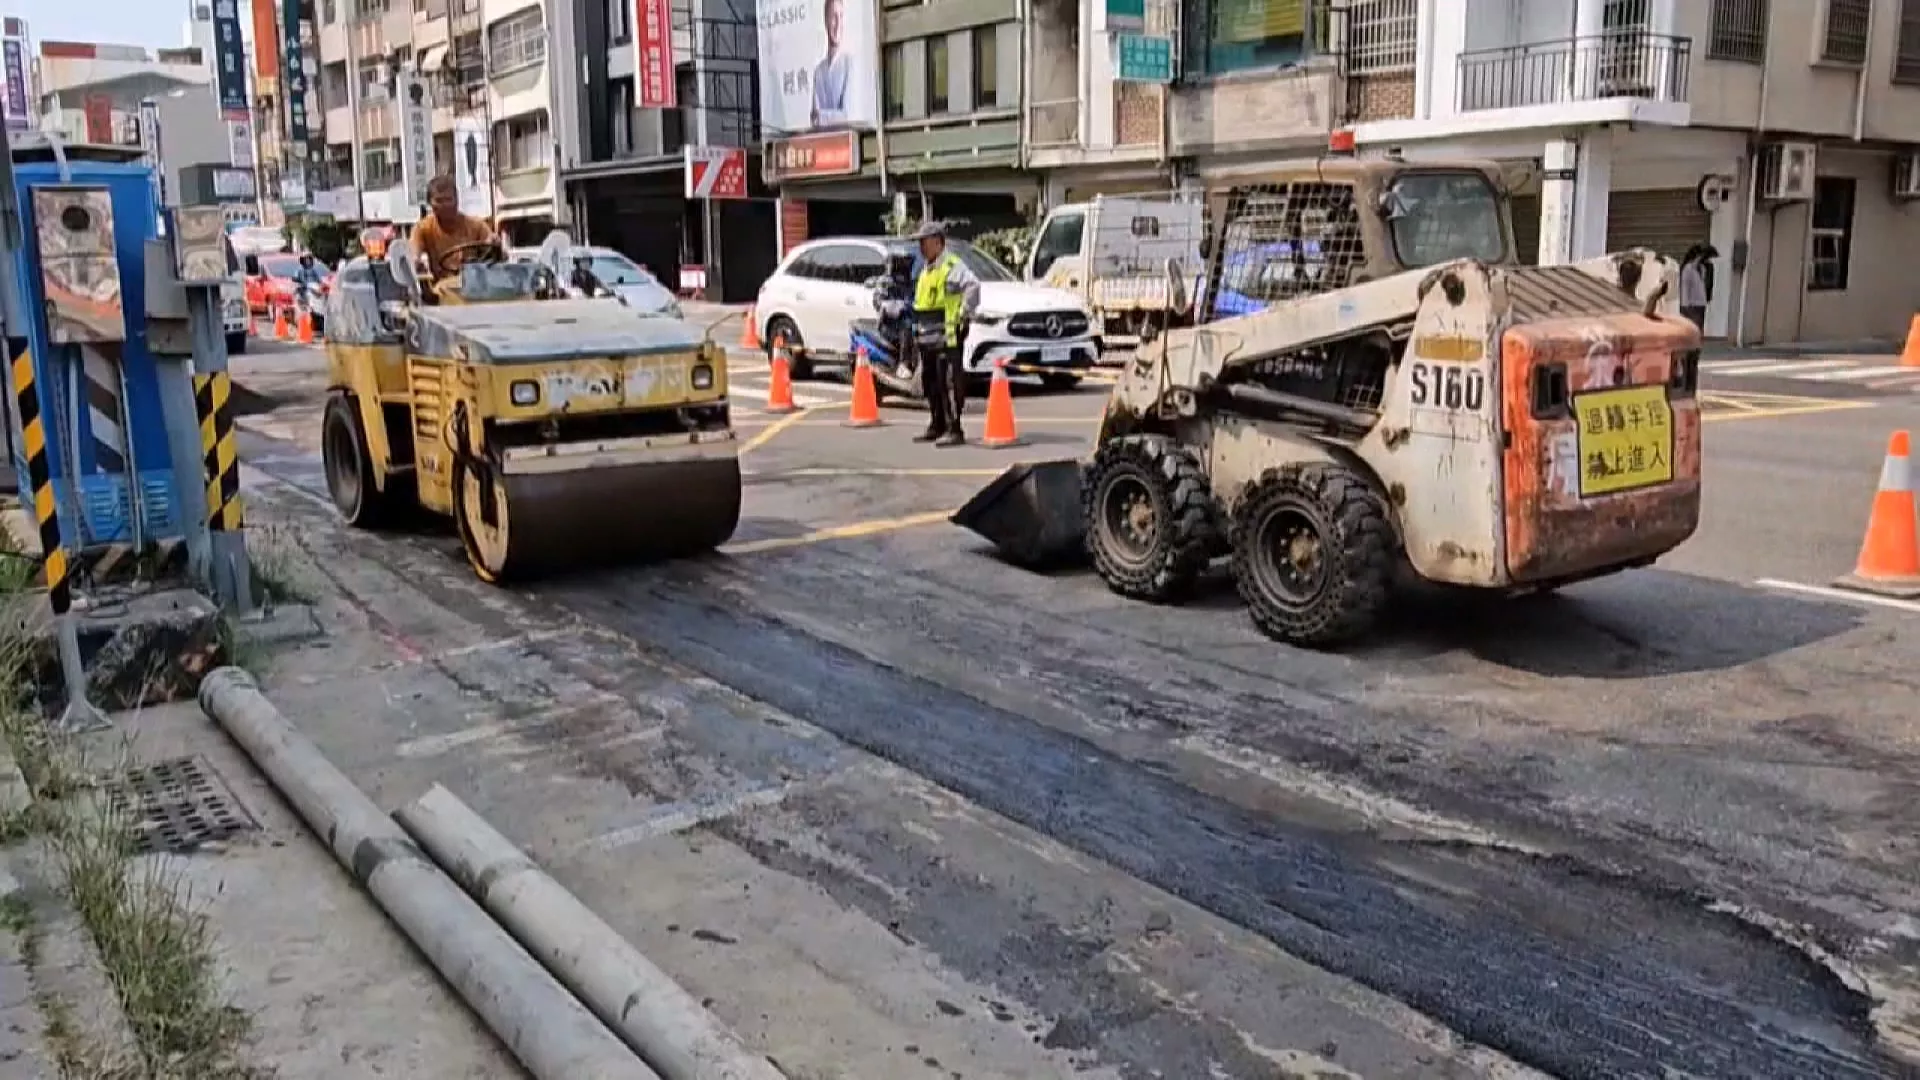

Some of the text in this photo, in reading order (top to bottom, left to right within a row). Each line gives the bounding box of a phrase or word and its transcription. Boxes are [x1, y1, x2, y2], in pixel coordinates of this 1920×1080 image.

[759, 5, 806, 29] CLASSIC
[1411, 360, 1484, 410] S160
[1586, 440, 1666, 480] 禁止進入
